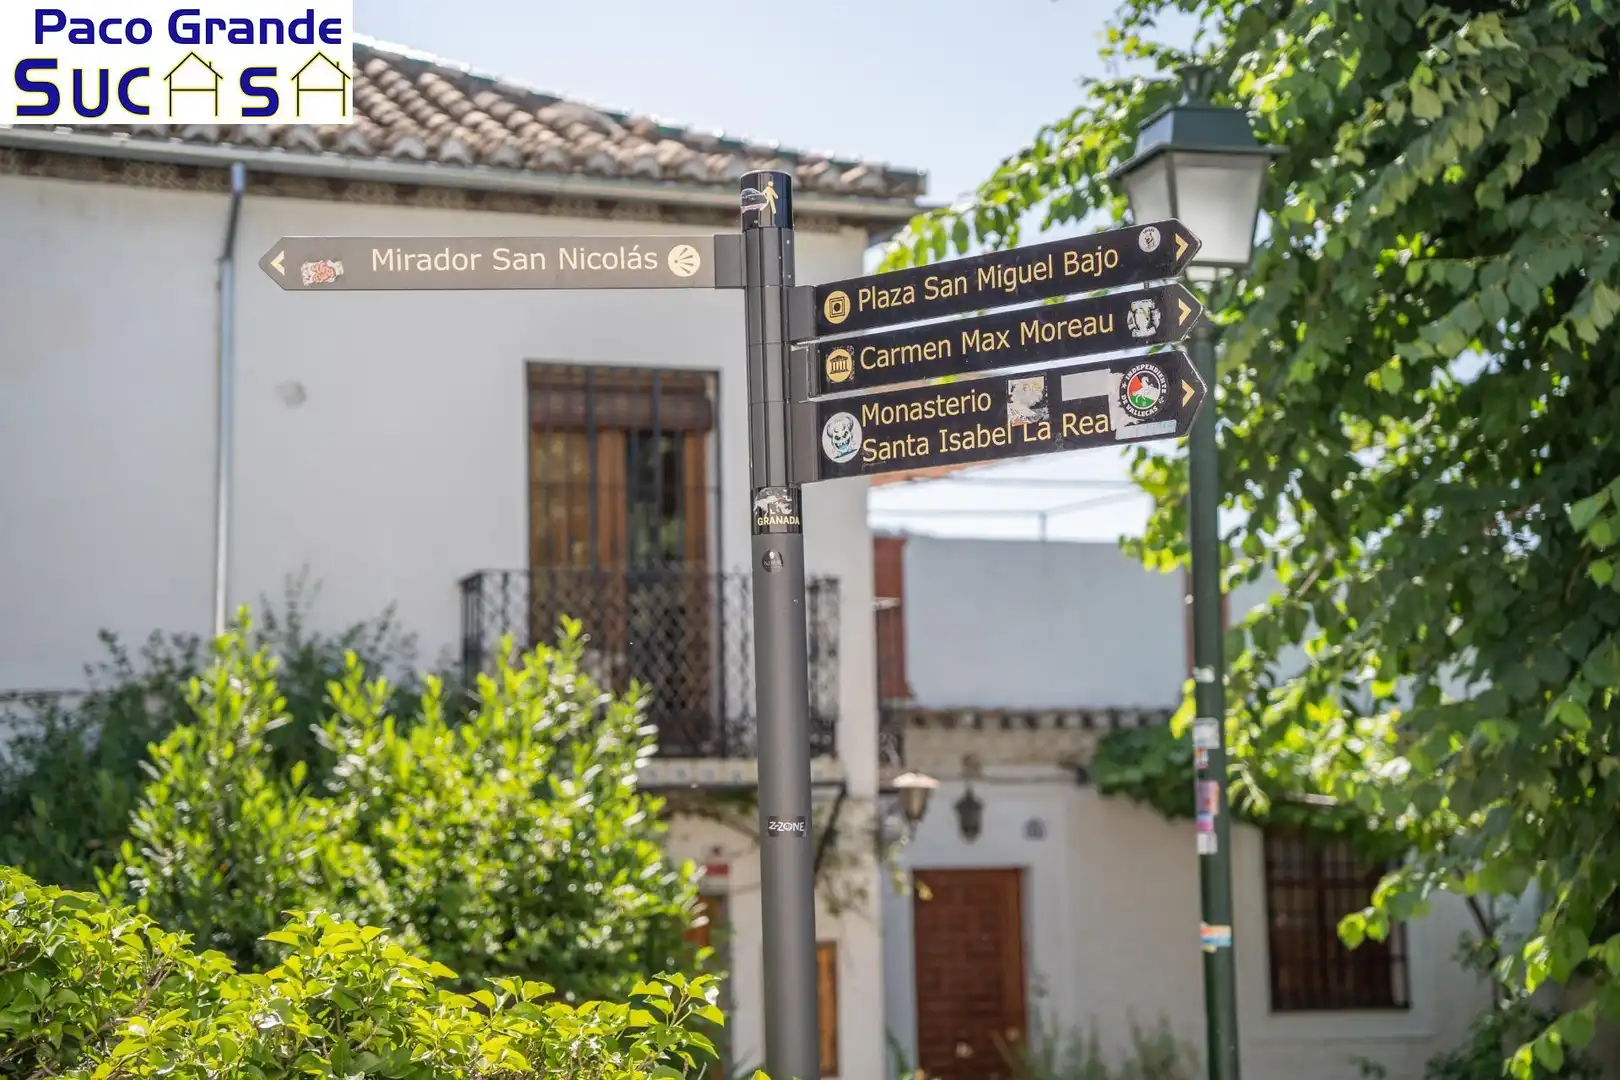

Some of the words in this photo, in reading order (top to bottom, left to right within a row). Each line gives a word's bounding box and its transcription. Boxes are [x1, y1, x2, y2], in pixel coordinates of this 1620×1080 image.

[372, 246, 484, 272] Mirador
[492, 247, 547, 271] San
[558, 244, 659, 271] Nicolás
[858, 285, 915, 313] Plaza
[924, 276, 967, 300] San
[977, 253, 1053, 293] Miguel
[1064, 245, 1119, 277] Bajo
[860, 339, 952, 370] Carmen
[962, 329, 1011, 355] Max
[1020, 313, 1115, 346] Moreau
[1125, 363, 1168, 394] INDEPENDIENTE
[862, 392, 992, 427] Monasterio
[1125, 403, 1159, 418] VALLECAS
[862, 434, 930, 462] Santa
[939, 420, 1013, 453] Isabel
[1022, 420, 1052, 442] La
[1062, 411, 1115, 438] Rea
[757, 515, 800, 526] GRANADA
[768, 821, 805, 832] Z-ZONE
